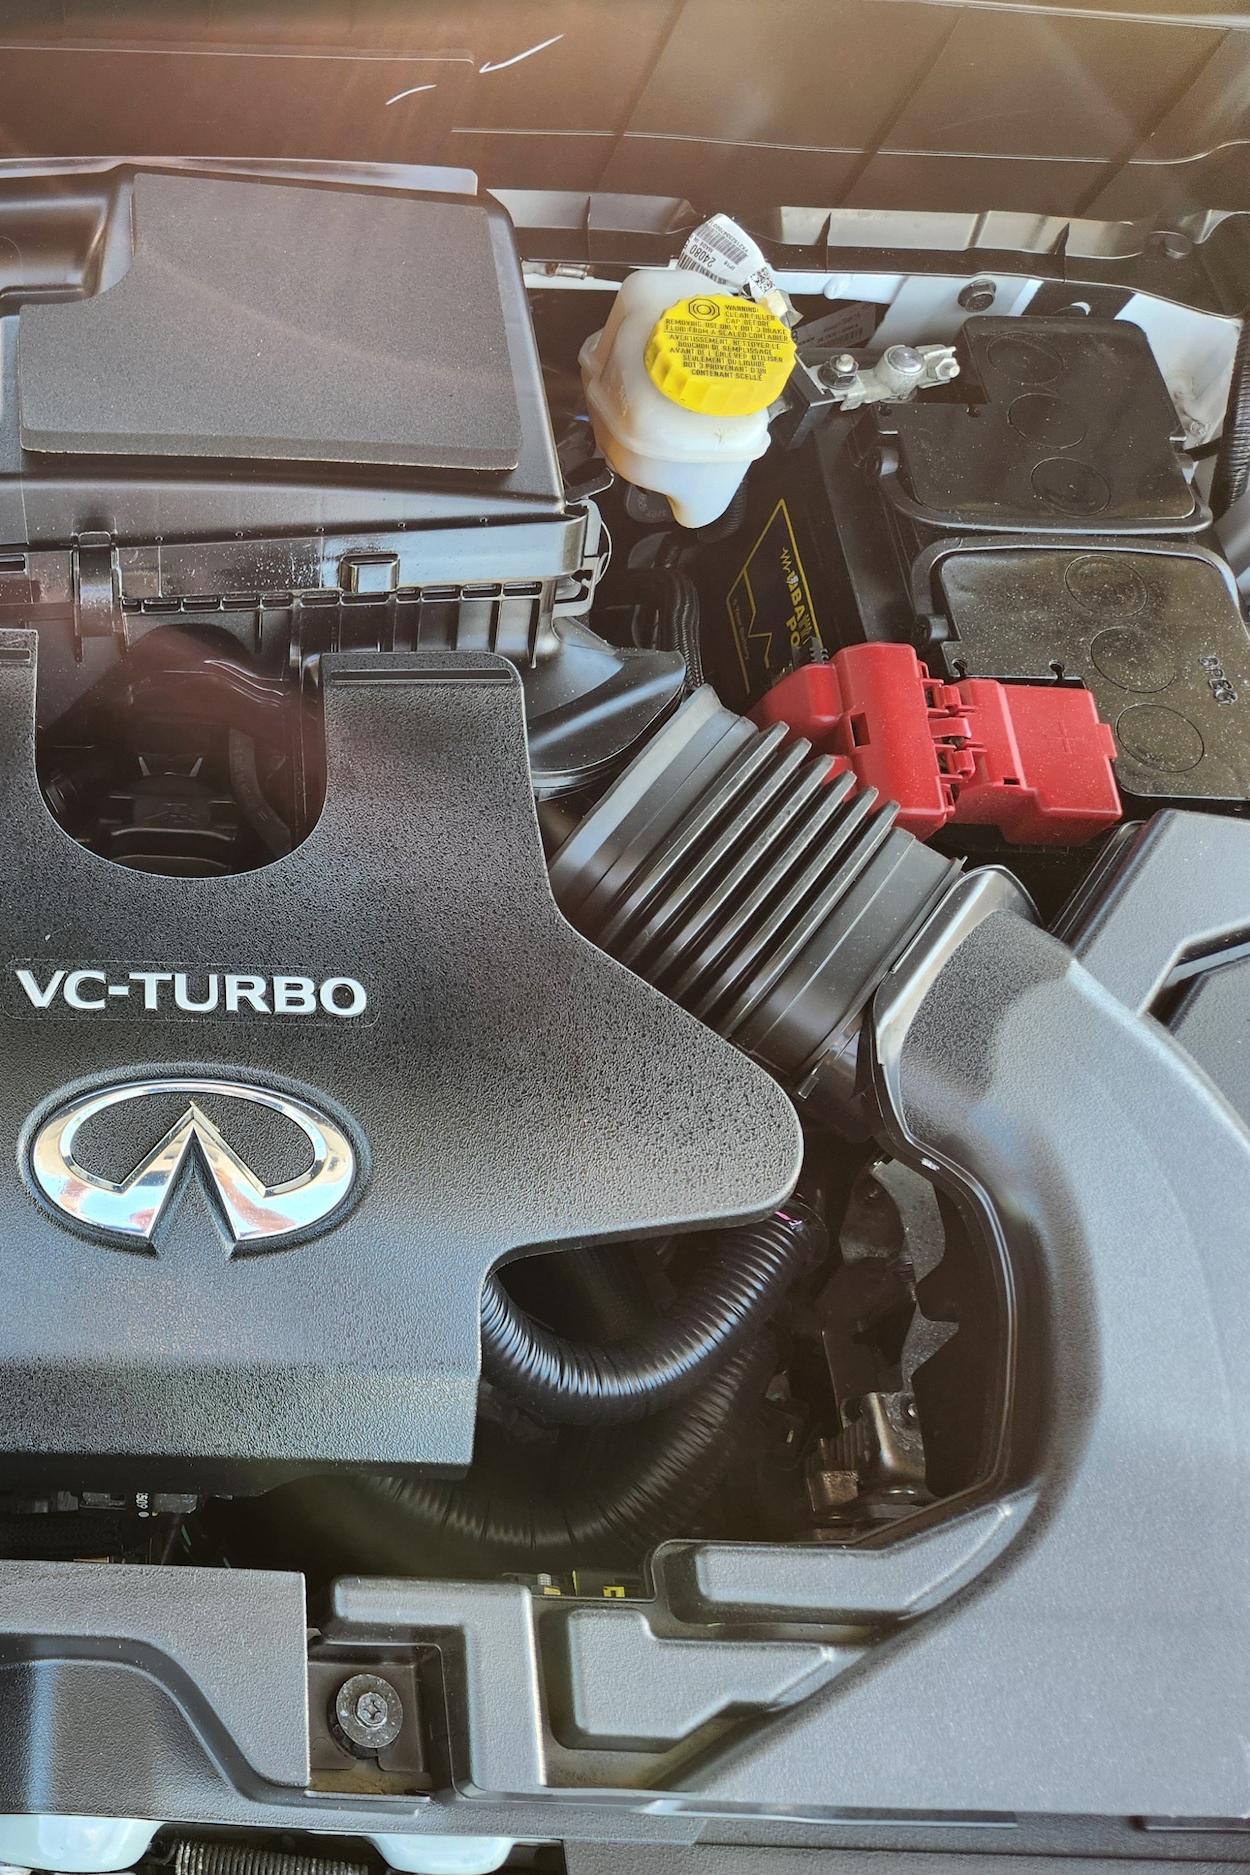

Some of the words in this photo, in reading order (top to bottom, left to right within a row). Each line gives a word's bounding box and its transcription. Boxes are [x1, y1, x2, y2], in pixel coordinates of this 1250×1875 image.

[690, 244, 716, 268] 24080
[678, 341, 709, 349] BOUCHON
[723, 346, 772, 355] REMPLISSAGE
[733, 340, 770, 349] NETTOYER
[683, 355, 725, 364] SEULEMENT
[739, 360, 765, 368] LIQUIDE
[752, 354, 783, 362] UTILISER
[706, 363, 748, 372] PROVENANT
[692, 369, 733, 378] CONTENANT
[15, 970, 367, 1017] VC-TURBO
